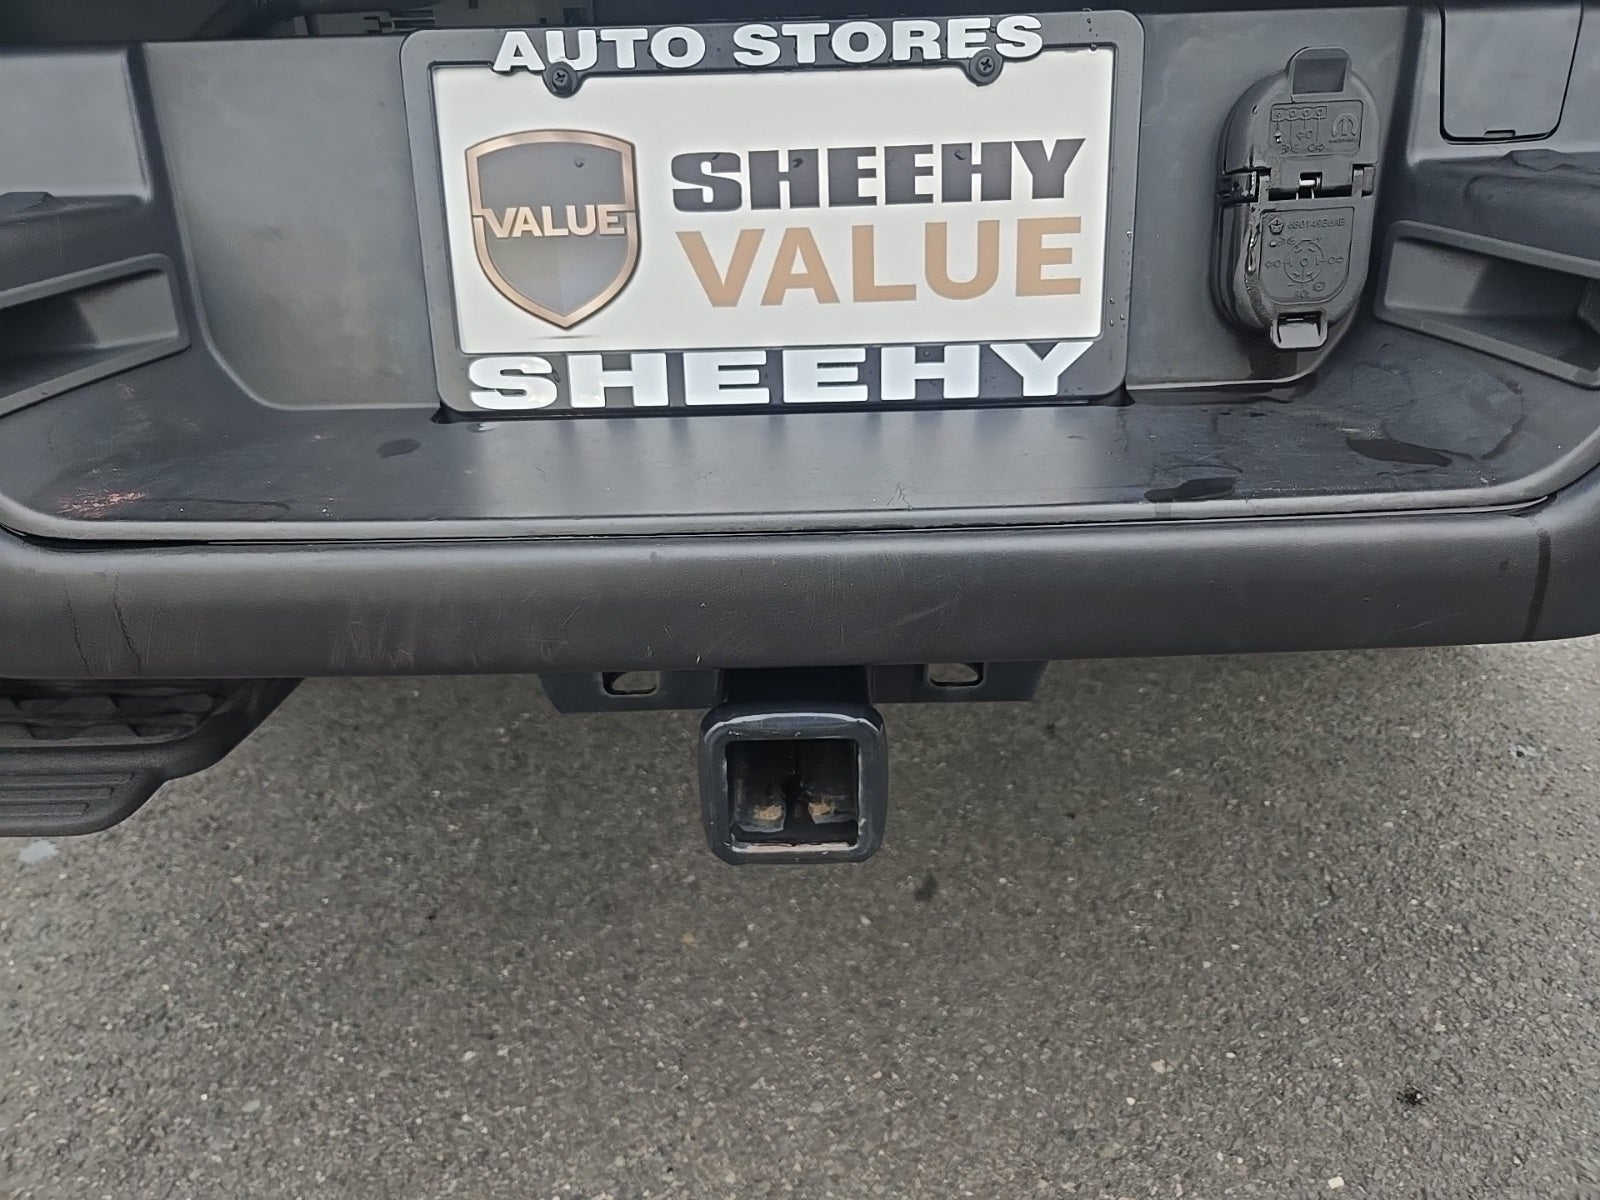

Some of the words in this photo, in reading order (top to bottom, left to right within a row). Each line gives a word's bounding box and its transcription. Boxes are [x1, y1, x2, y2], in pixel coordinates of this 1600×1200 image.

[493, 27, 706, 72] AUTO
[732, 15, 1043, 66] STORES
[671, 138, 1086, 213] SHEEHY
[484, 204, 627, 239] VALUE
[675, 216, 1082, 308] VALUE
[468, 341, 1094, 411] SHEEHY
